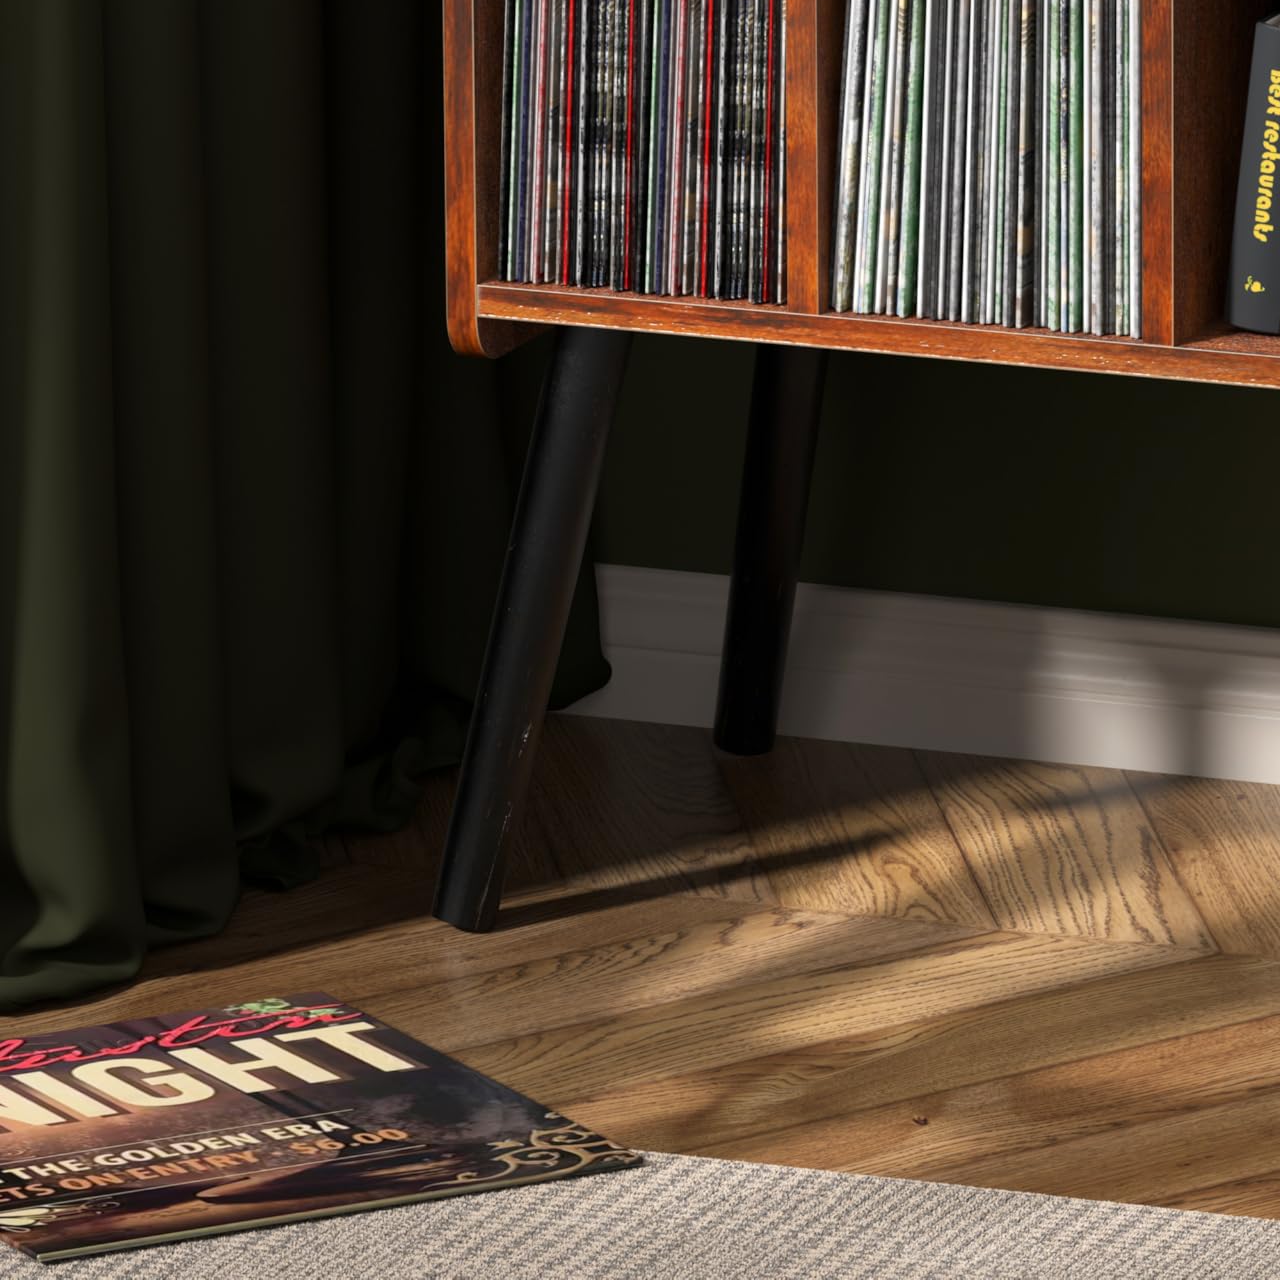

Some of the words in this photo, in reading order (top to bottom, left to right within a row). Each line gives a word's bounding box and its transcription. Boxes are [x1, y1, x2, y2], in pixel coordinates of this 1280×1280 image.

[4, 1158, 91, 1180] THE
[94, 1132, 263, 1167] GOLDEN
[261, 1120, 350, 1141] ERA
[59, 1172, 125, 1191] ON
[127, 1150, 260, 1181] ENTRY
[289, 1128, 409, 1155] $6.00
